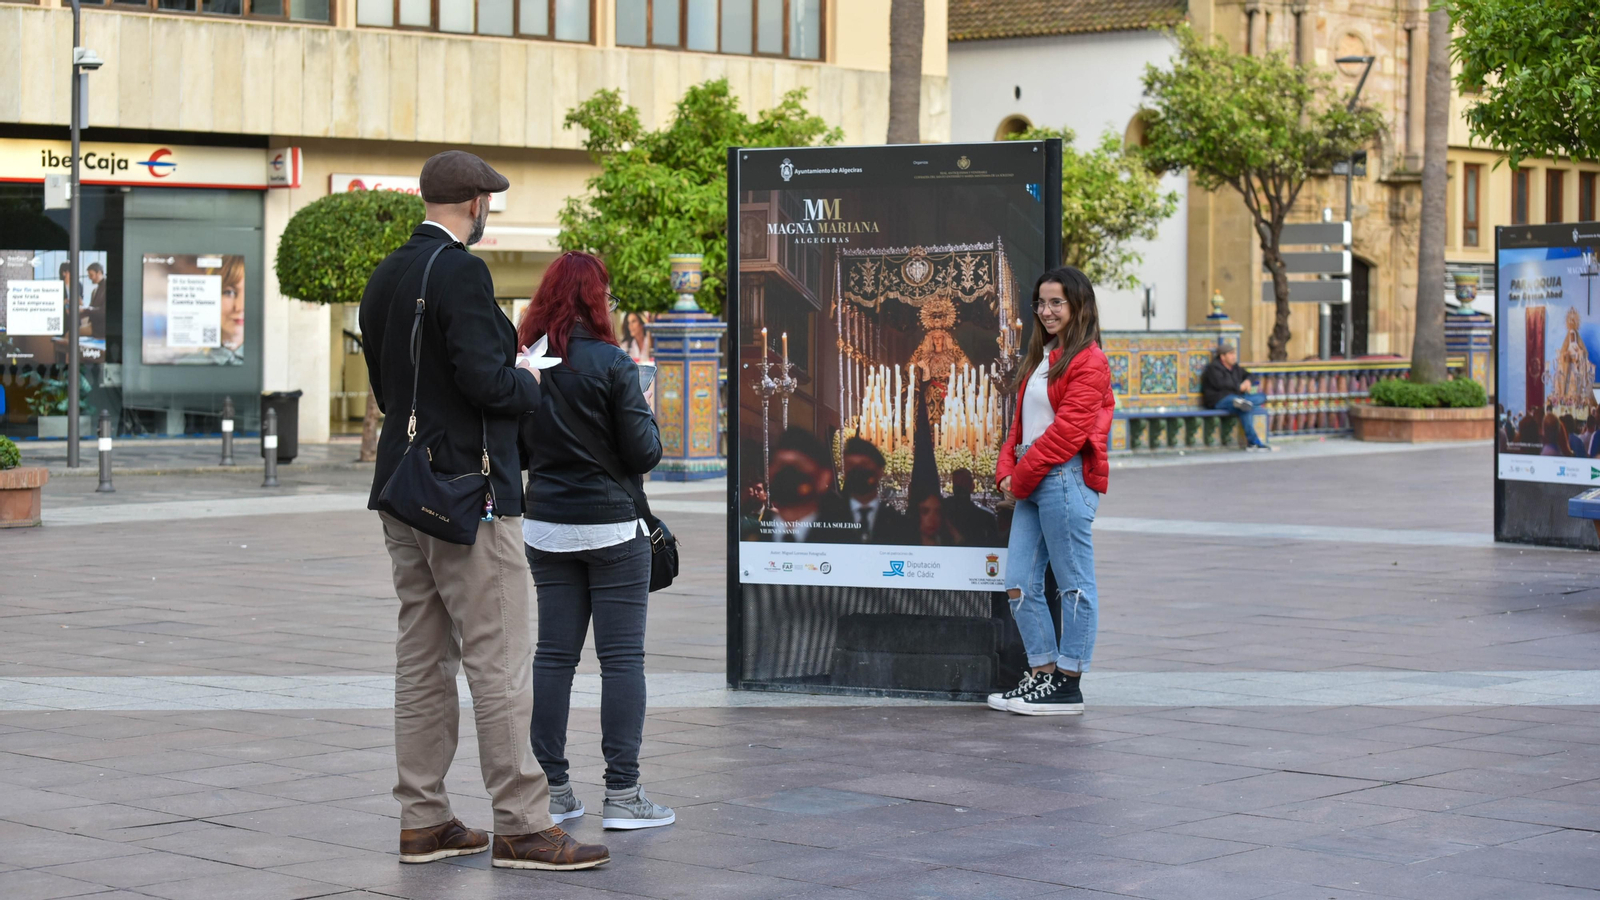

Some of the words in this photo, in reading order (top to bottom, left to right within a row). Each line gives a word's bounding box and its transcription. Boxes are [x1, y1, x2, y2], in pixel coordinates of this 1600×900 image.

[839, 166, 862, 175] Algeciras
[803, 198, 842, 221] MM
[767, 222, 814, 235] MAGNA
[818, 221, 880, 234] MARIANA
[1546, 289, 1563, 299] Abad
[760, 518, 780, 527] MARÍA
[781, 519, 813, 528] SANTÍSIMA
[832, 521, 862, 529] SOLEDAD
[907, 560, 940, 569] Diputación
[917, 570, 935, 578] Cádiz
